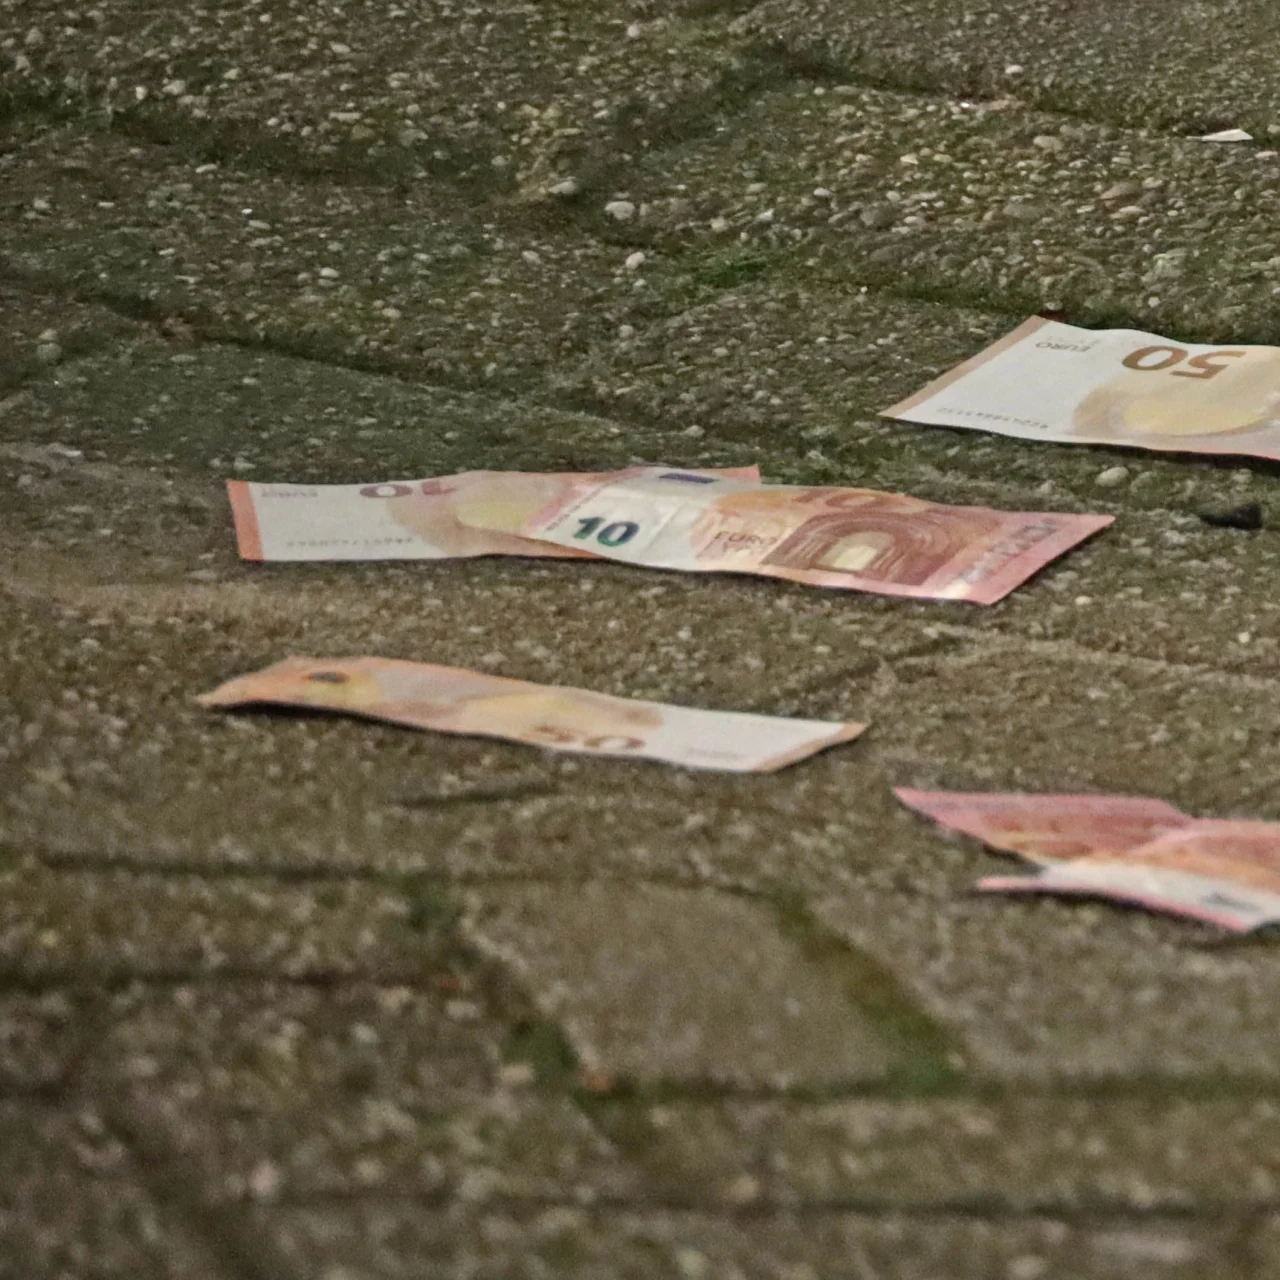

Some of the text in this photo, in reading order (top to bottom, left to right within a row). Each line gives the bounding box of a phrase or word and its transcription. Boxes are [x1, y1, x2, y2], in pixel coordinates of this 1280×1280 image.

[1035, 340, 1092, 353] EURO
[1122, 345, 1247, 380] 50
[359, 481, 458, 499] 10
[573, 516, 641, 548] 10
